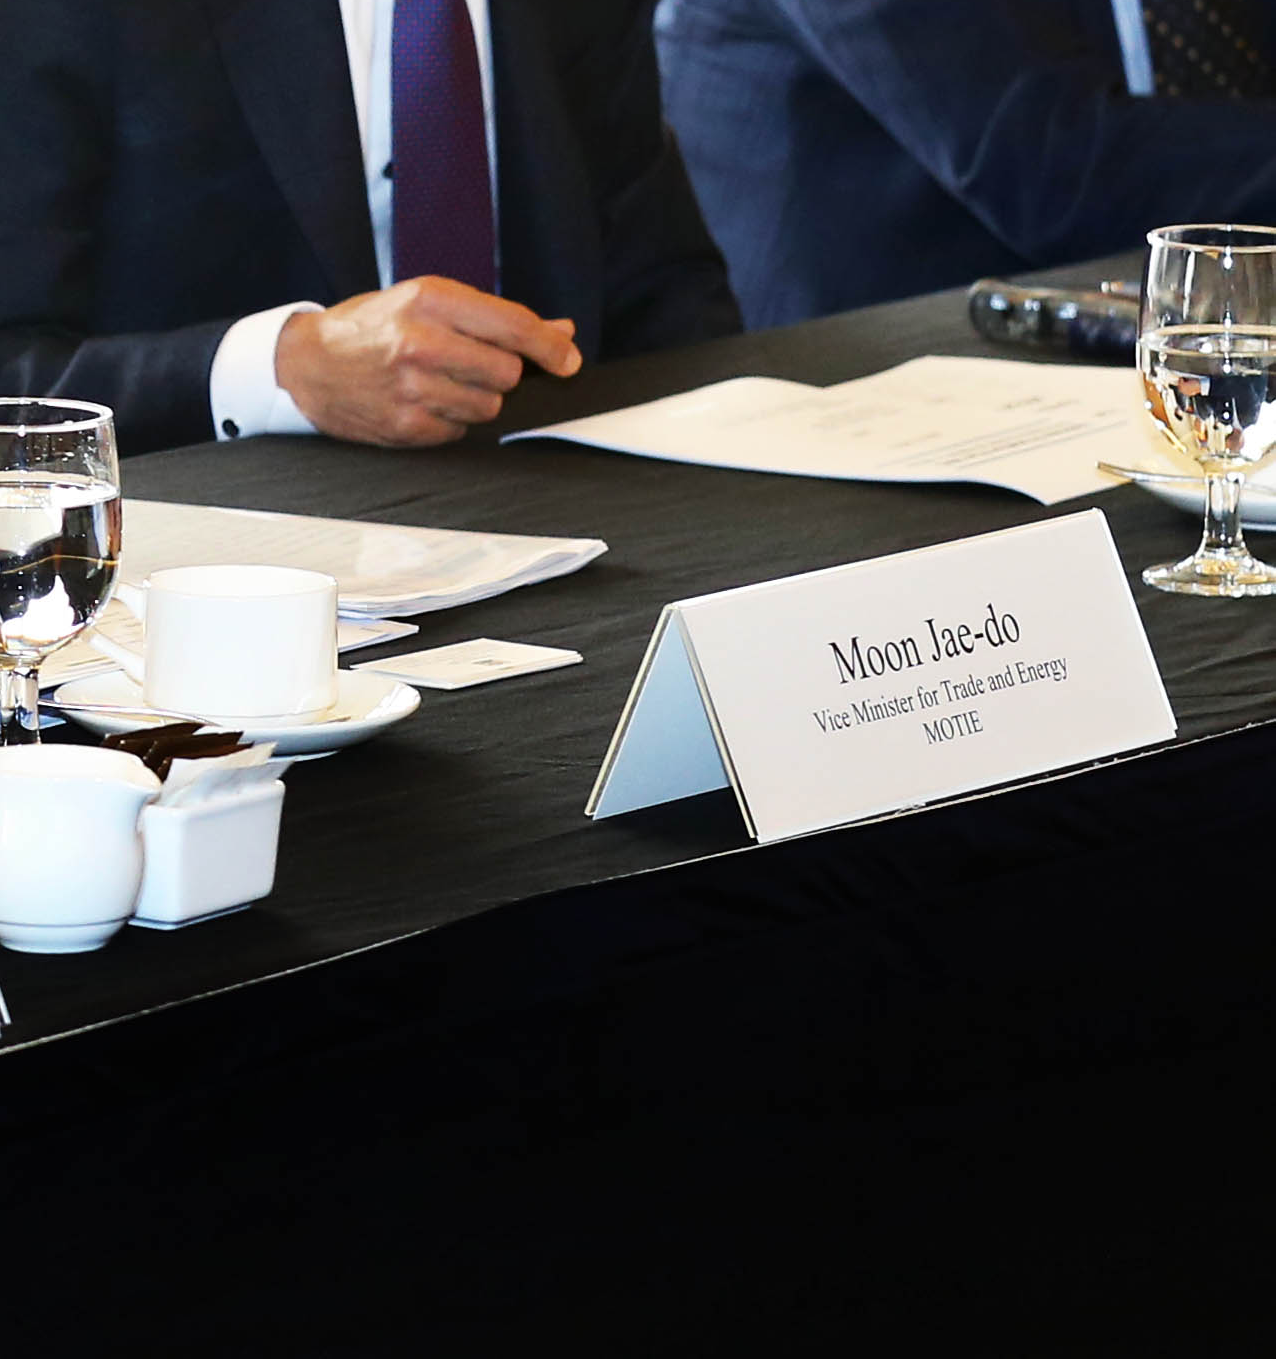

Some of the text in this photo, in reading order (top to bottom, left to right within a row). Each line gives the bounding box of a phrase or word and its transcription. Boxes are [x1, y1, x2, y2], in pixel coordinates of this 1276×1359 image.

[828, 603, 1021, 684] Moon Jae-do
[812, 657, 1067, 733] Vice Minister for Trade and Energy
[922, 710, 984, 744] MOTIE
